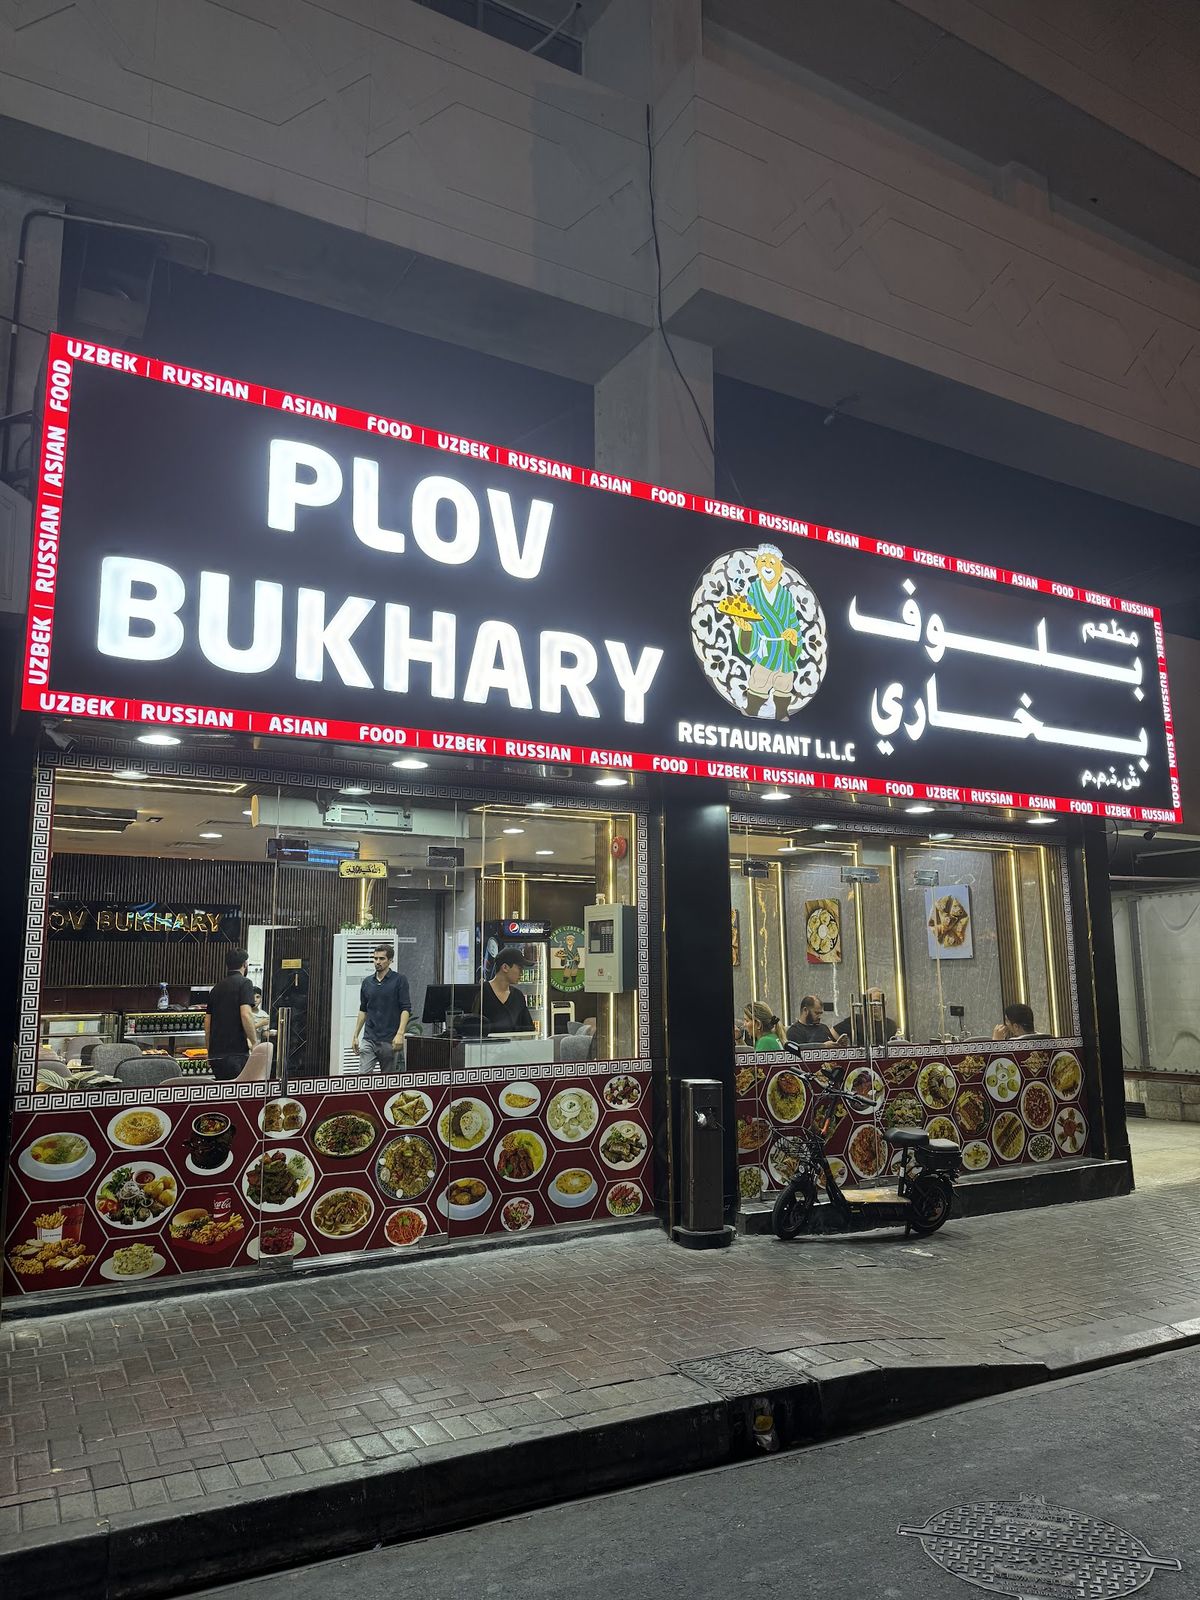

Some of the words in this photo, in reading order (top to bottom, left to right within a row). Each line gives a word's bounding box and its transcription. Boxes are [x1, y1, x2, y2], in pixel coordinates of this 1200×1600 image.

[49, 359, 71, 413] FOOD
[43, 425, 66, 488] ASIAN
[66, 339, 138, 374] UZBEK
[162, 365, 249, 400] RUSSIAN
[281, 395, 337, 423] ASIAN
[367, 416, 413, 441] FOOD
[437, 433, 490, 461] UZBEK
[508, 451, 572, 481] RUSSIAN
[589, 472, 632, 495] ASIAN
[651, 487, 686, 508] FOOD
[704, 500, 745, 522] UZBEK
[758, 512, 809, 537] RUSSIAN
[826, 529, 860, 549] ASIAN
[876, 541, 904, 560] FOOD
[913, 550, 946, 569] UZBEK
[956, 560, 997, 581] RUSSIAN
[1011, 573, 1039, 590] ASIAN
[1051, 583, 1075, 599] FOOD
[1085, 591, 1112, 609] UZBEK
[1120, 600, 1154, 618] RUSSIAN
[267, 438, 554, 580] PLOV
[35, 504, 60, 594] RUSSIAN
[28, 615, 52, 685] UZBEK
[97, 555, 664, 724] BUKHARY
[848, 578, 1145, 702] بلوف
[1081, 619, 1139, 648] مطعم
[1153, 621, 1165, 659] UZBEK
[871, 672, 1150, 773] بخاري
[1158, 671, 1172, 722] RUSSIAN
[39, 692, 115, 717] UZBEK
[141, 702, 234, 728] RUSSIAN
[268, 716, 328, 737] ASIAN
[359, 725, 407, 745] FOOD
[432, 733, 487, 753] UZBEK
[505, 741, 571, 762] RUSSIAN
[589, 750, 633, 770] ASIAN
[652, 756, 689, 773] FOOD
[707, 762, 749, 779] UZBEK
[763, 768, 815, 786] RUSSIAN
[833, 776, 868, 792] ASIAN
[885, 782, 914, 797] FOOD
[925, 786, 960, 801] UZBEK
[970, 790, 1014, 805] RUSSIAN
[1028, 796, 1057, 811] ASIAN
[1069, 800, 1094, 814] FOOD
[1104, 804, 1132, 818] UZBEK
[1141, 807, 1176, 822] RUSSIAN
[678, 721, 812, 757] RESTAURANT
[815, 738, 856, 762] L.L.C
[1165, 731, 1177, 768] ASIAN
[1170, 776, 1181, 809] FOOD
[97, 911, 221, 932] BUKHARY
